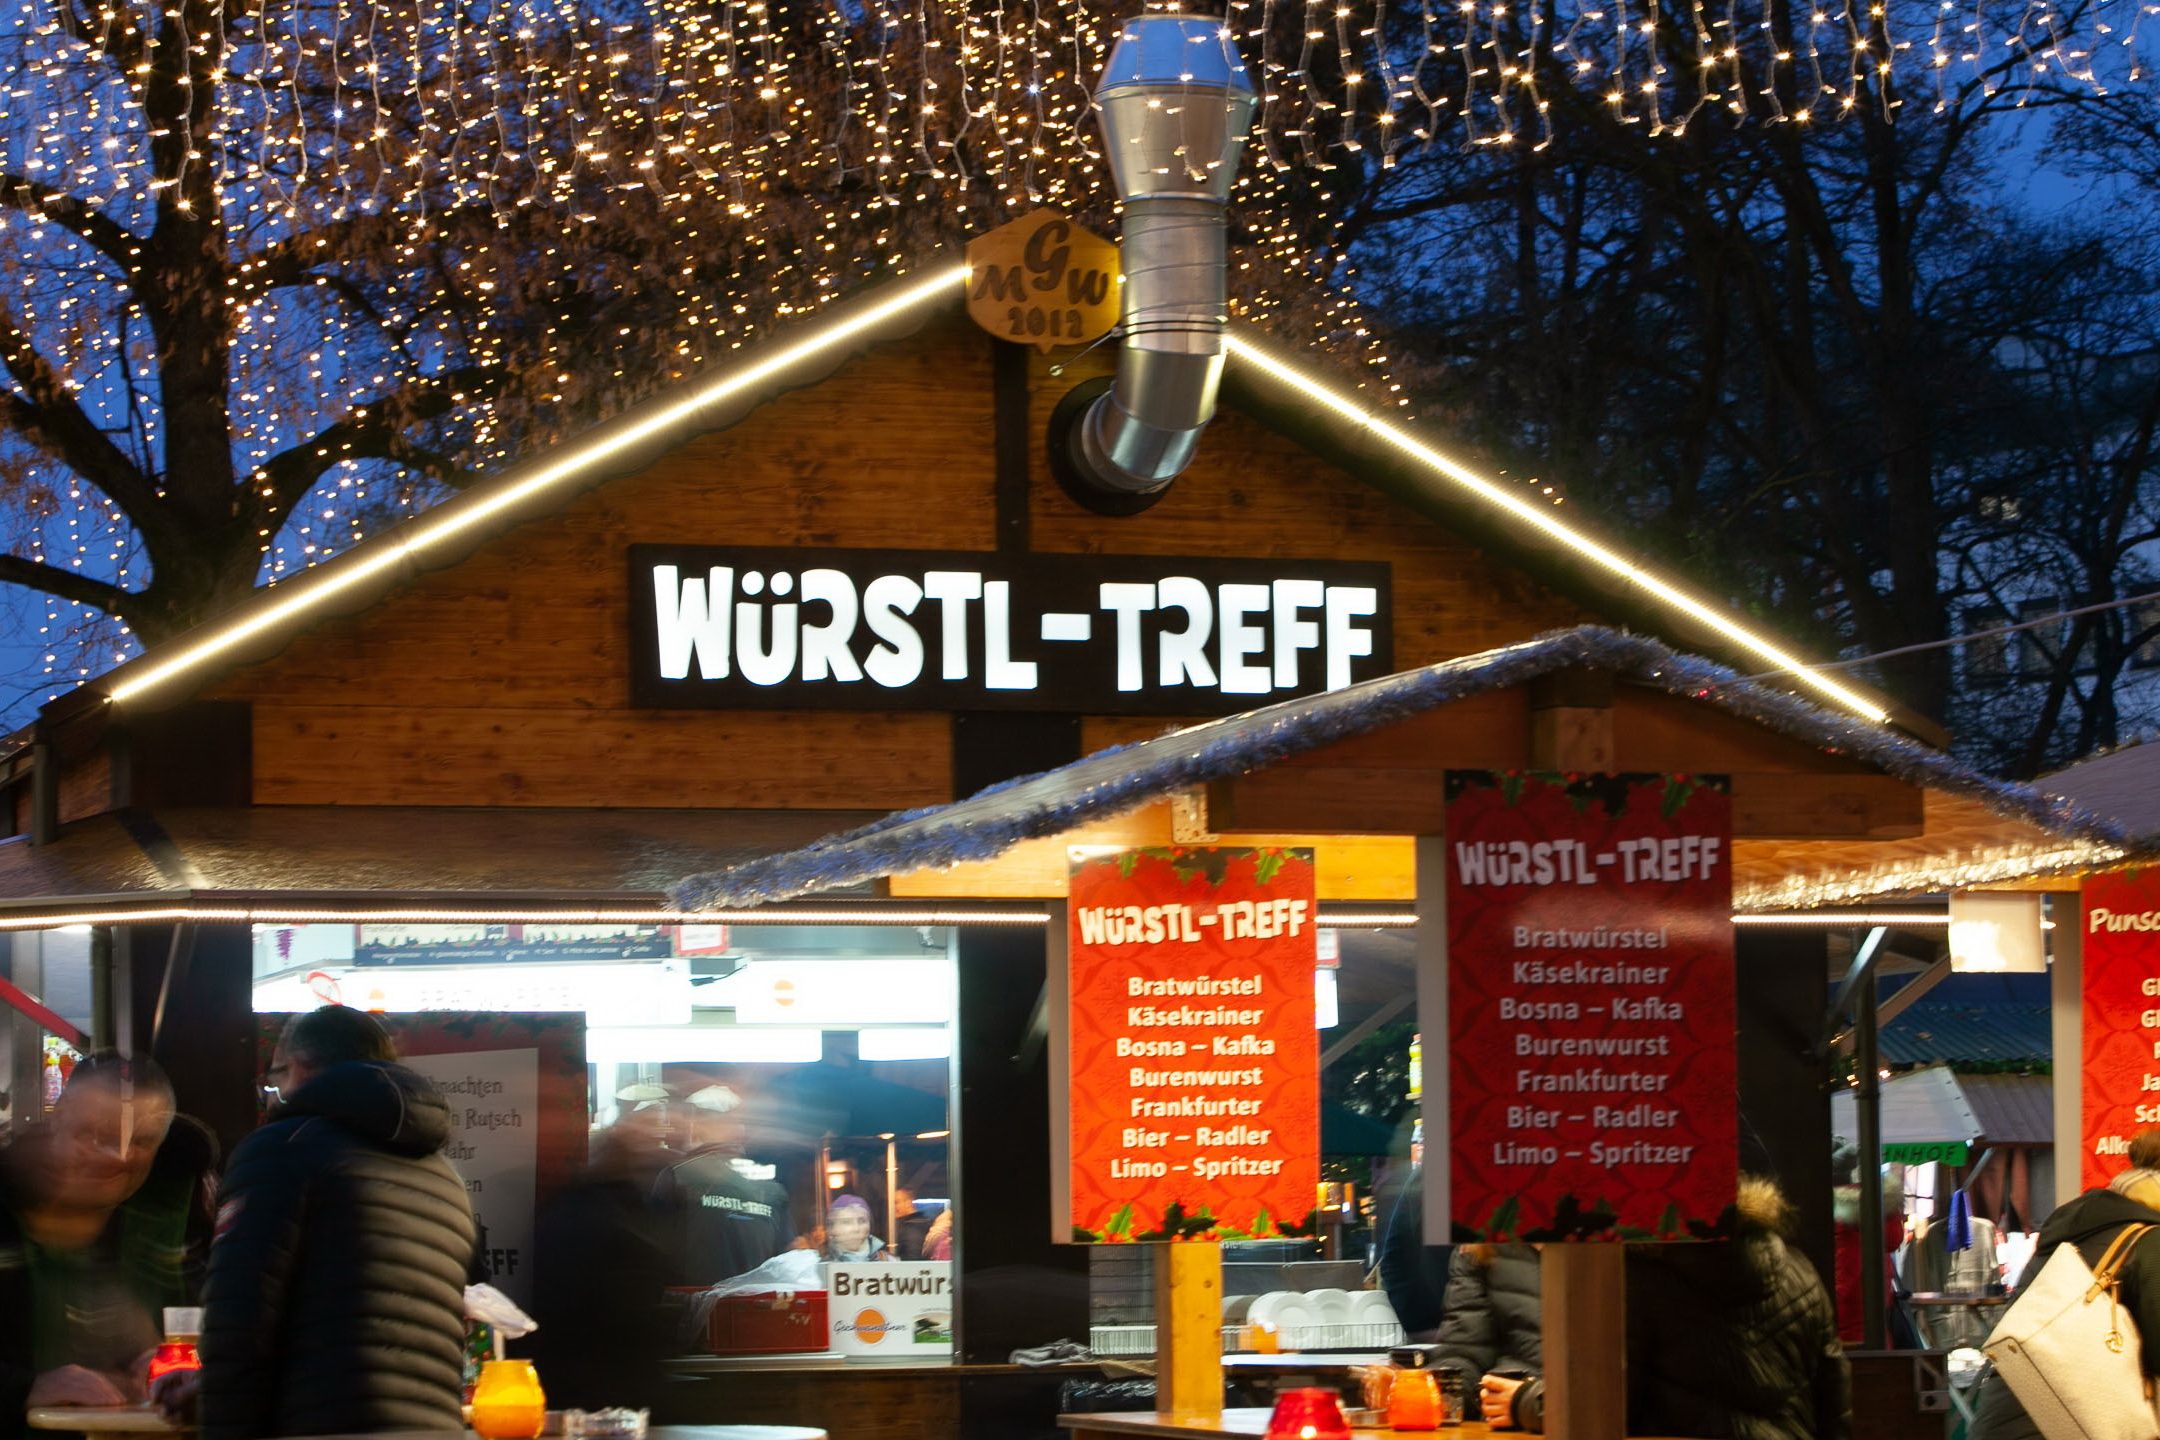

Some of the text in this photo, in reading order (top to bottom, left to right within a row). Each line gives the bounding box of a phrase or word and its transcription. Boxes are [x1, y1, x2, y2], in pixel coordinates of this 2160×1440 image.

[1008, 306, 1083, 338] 2012
[653, 564, 1377, 694] WÜRSTL-TREFF
[1455, 836, 1719, 886] WÜRSTL-TREFF
[1078, 898, 1308, 946] WÜRSTL-TREFF
[1513, 925, 1667, 950] Bratwürstel
[1128, 974, 1262, 997] Bratwürstel
[1513, 962, 1669, 985] Käsekrainer
[1127, 1006, 1263, 1027] Käsekrainer
[1500, 998, 1579, 1021] Bosna
[1611, 997, 1683, 1021] Kafka
[1116, 1037, 1186, 1057] Bosna
[1212, 1035, 1275, 1056] Kafka
[1515, 1033, 1669, 1057] Burenwurst
[1130, 1067, 1263, 1087] Burenwurst
[1516, 1068, 1669, 1093] Frankfurter
[464, 1108, 523, 1130] Rutsch
[1131, 1096, 1262, 1118] Frankfurter
[1507, 1105, 1562, 1129] Bier
[1592, 1104, 1679, 1128] Radler
[1122, 1127, 1170, 1148] Bier
[1195, 1125, 1271, 1147] Radler
[1493, 1142, 1558, 1165] Limo
[1589, 1142, 1693, 1168] Spritzer
[1111, 1158, 1167, 1179] Limo
[1193, 1156, 1283, 1181] Spritzer
